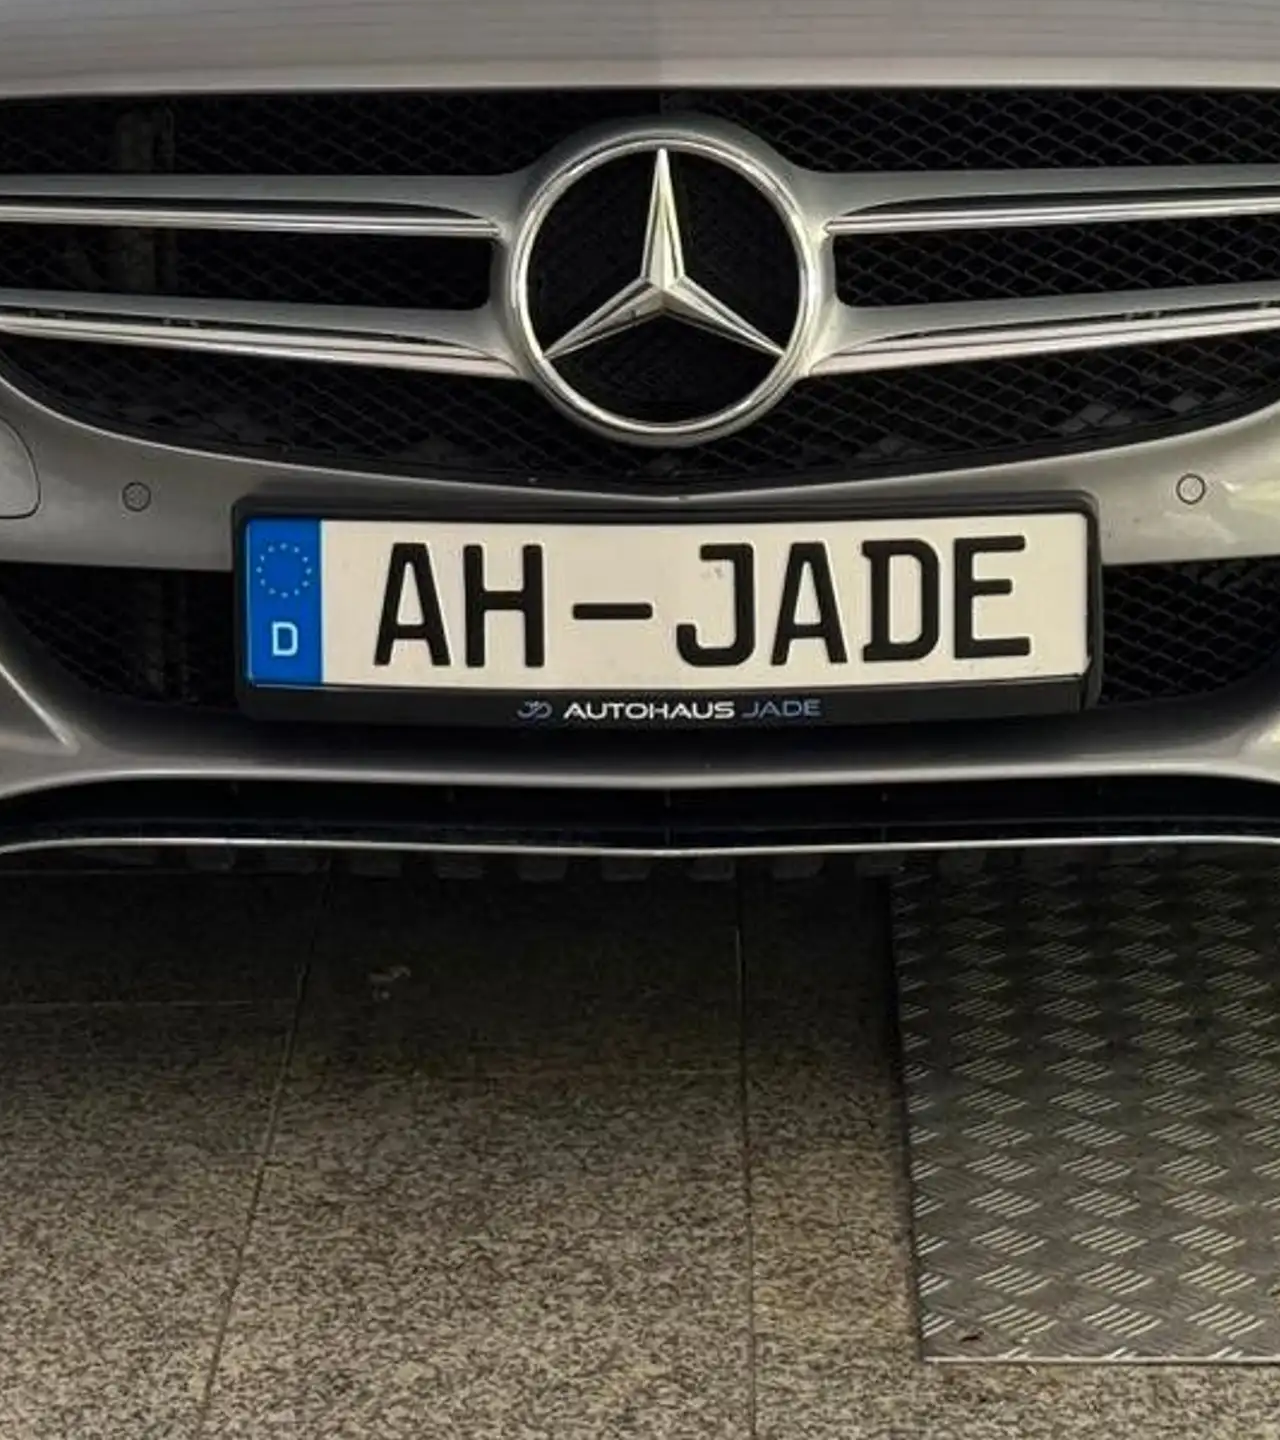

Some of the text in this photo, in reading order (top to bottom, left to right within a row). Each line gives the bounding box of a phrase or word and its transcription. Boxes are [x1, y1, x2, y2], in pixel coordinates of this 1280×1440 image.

[271, 622, 298, 657] D
[563, 701, 735, 720] AUTOHAUS
[741, 698, 821, 718] JADE
